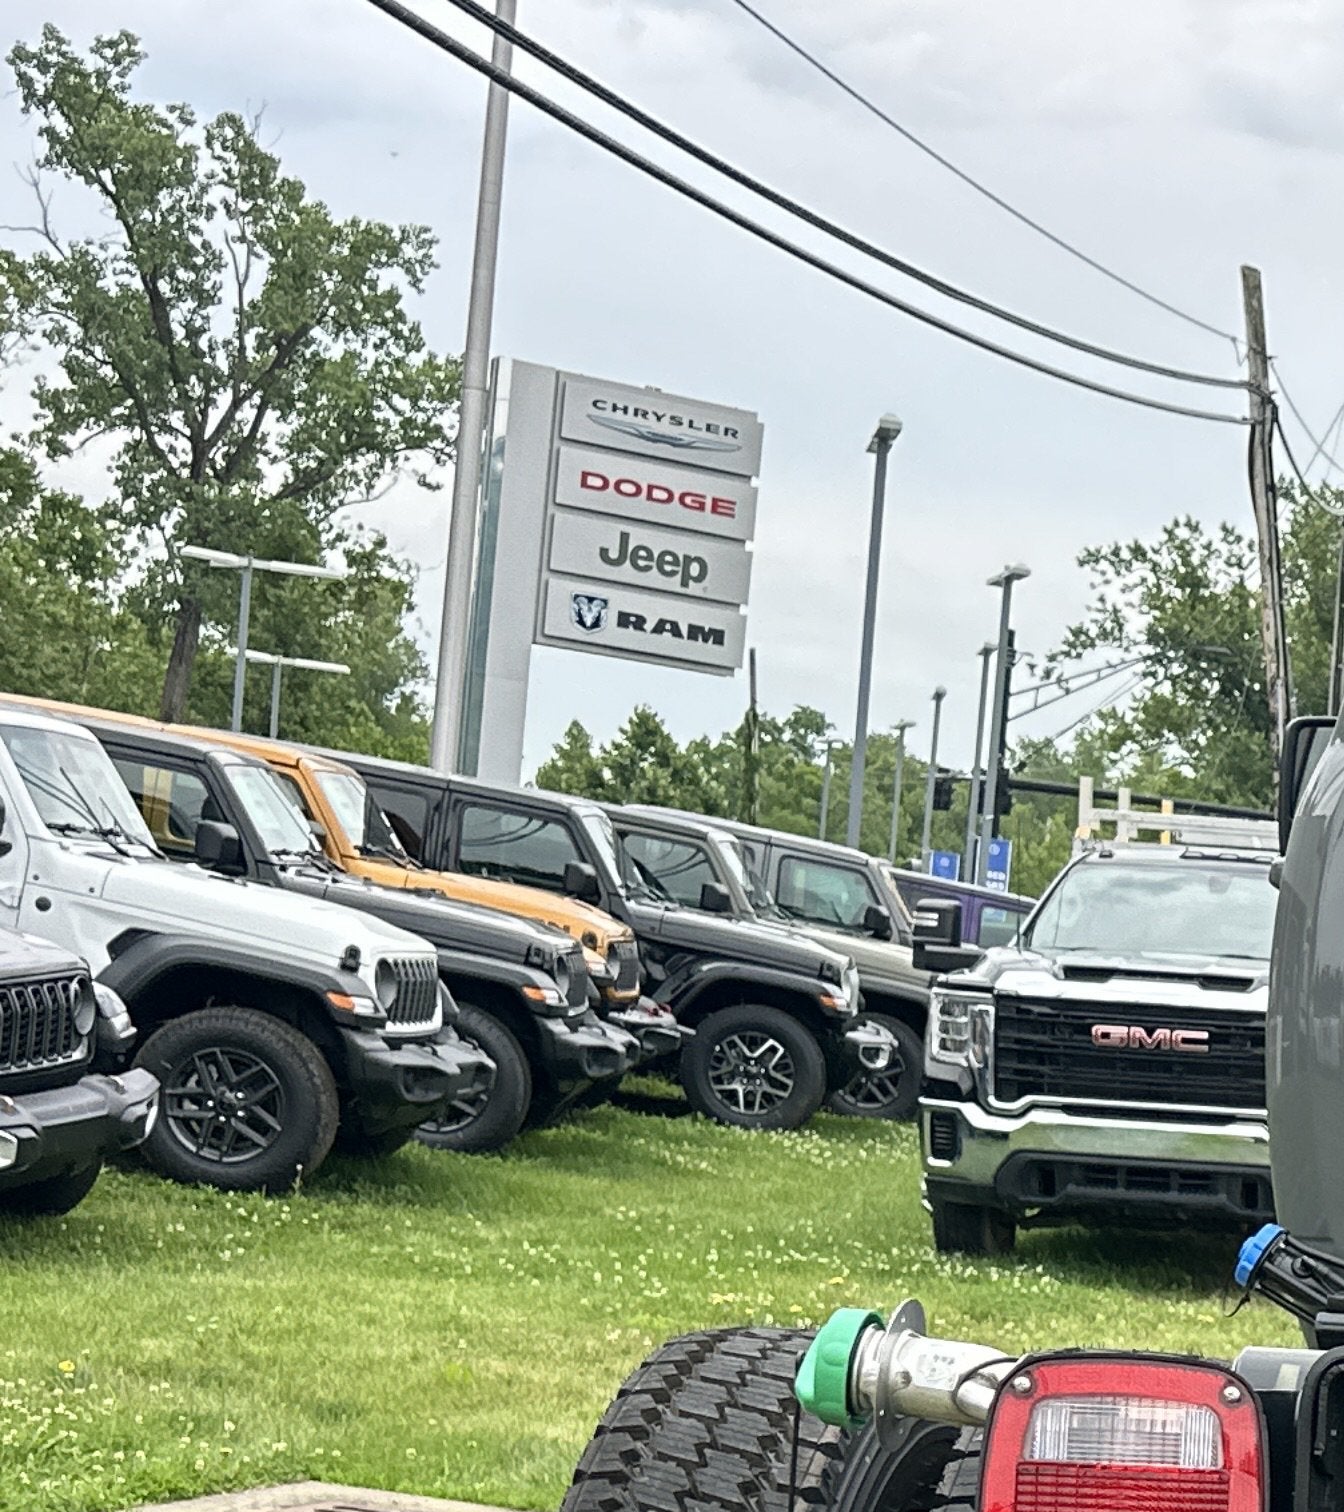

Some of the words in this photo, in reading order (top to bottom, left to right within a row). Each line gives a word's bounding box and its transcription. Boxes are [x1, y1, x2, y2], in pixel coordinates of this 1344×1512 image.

[592, 399, 739, 439] CHRYSLER
[580, 471, 736, 519] DODGE
[600, 531, 708, 588] Jeep
[617, 610, 725, 647] RAM
[1091, 1024, 1210, 1052] GMC
